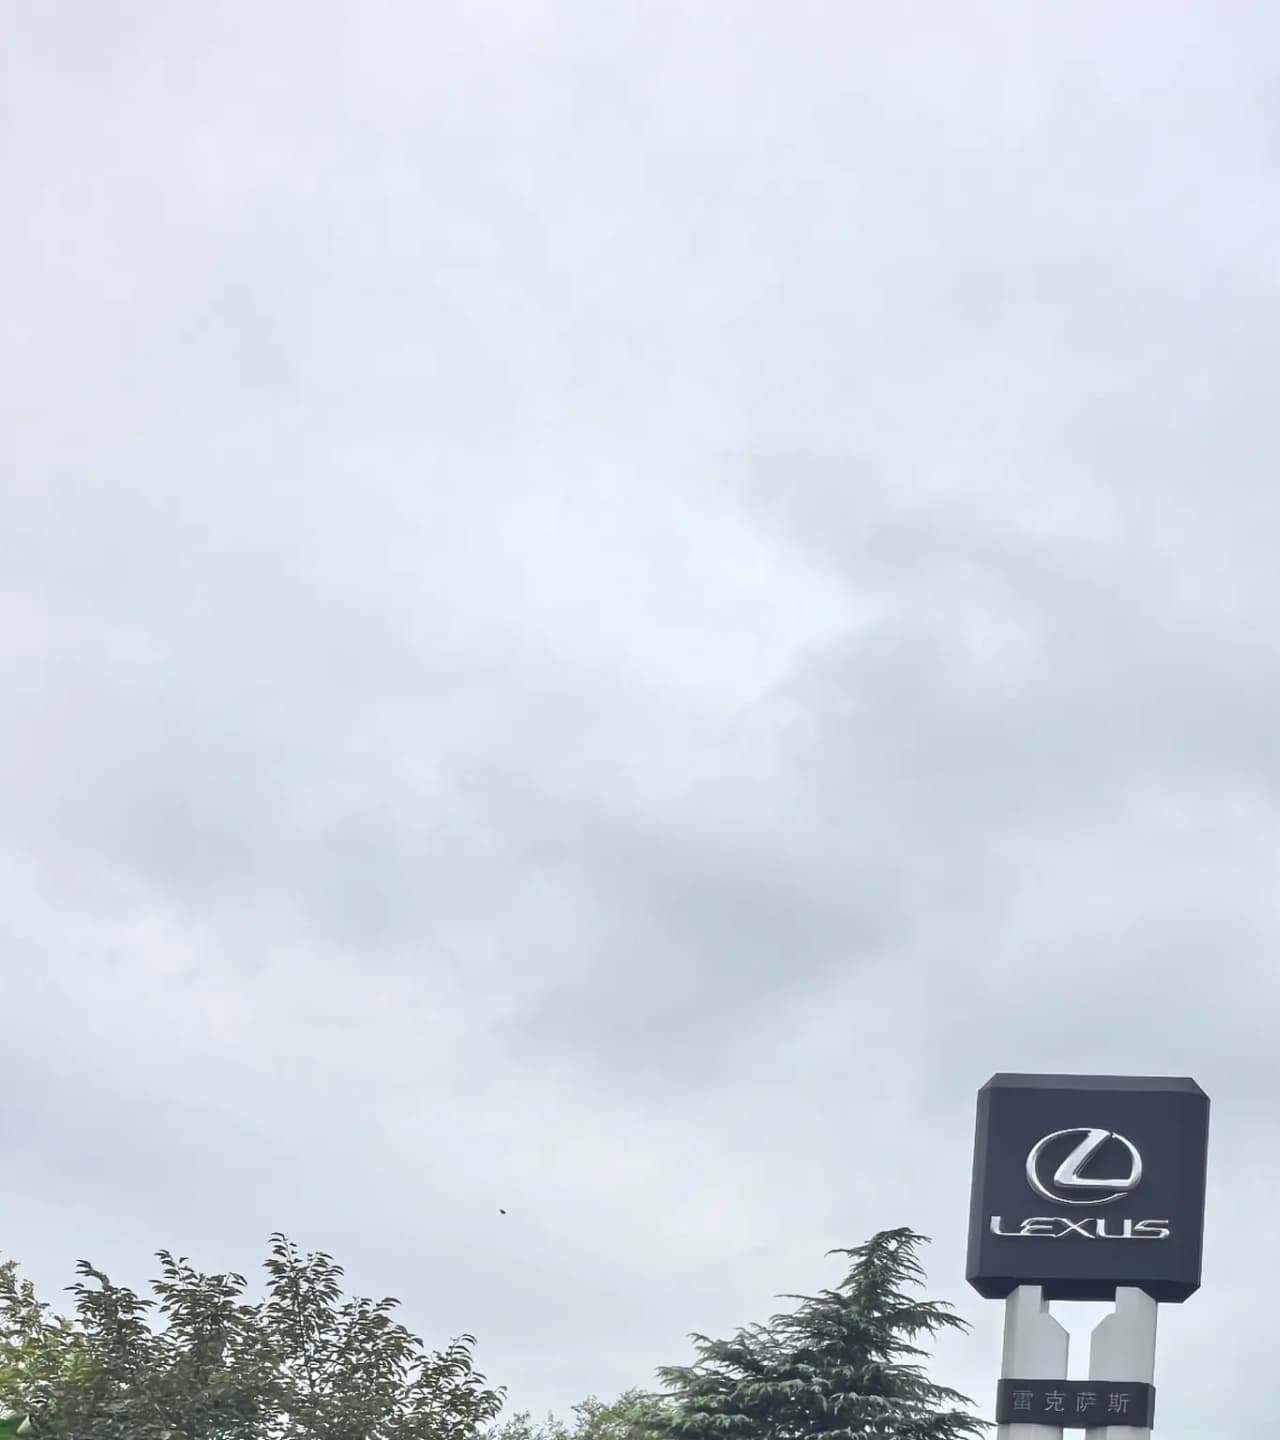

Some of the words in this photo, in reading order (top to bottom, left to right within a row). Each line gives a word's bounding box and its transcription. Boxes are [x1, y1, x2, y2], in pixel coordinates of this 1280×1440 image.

[990, 1215, 1170, 1240] LEXUS
[1012, 1390, 1131, 1414] 雷克萨斯
